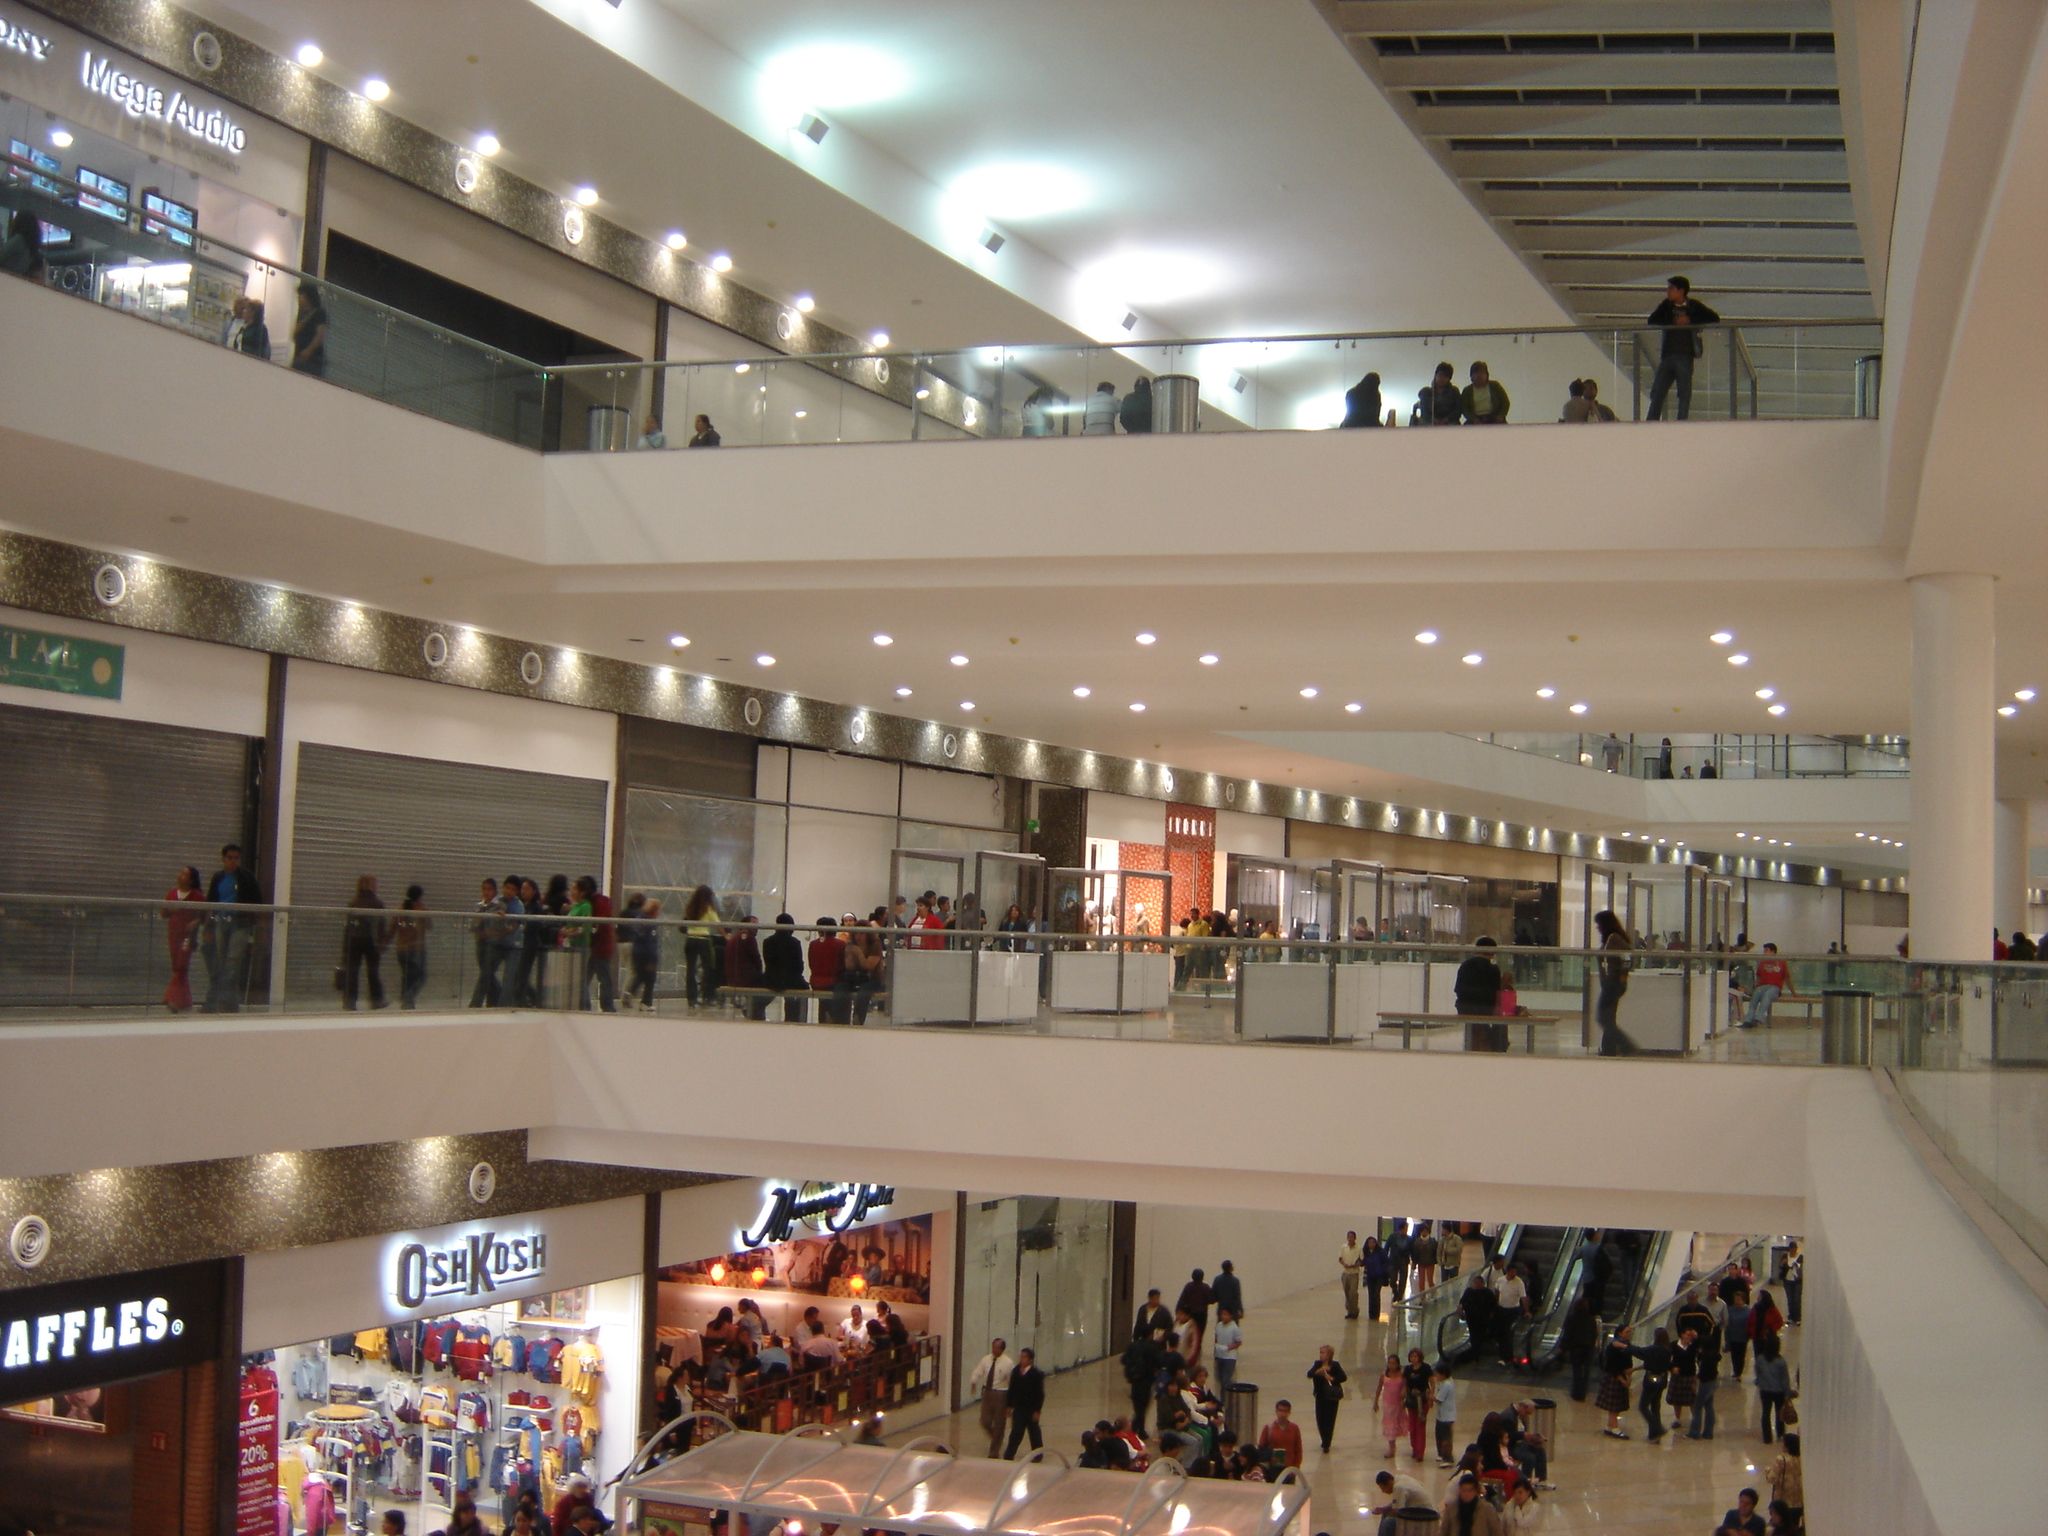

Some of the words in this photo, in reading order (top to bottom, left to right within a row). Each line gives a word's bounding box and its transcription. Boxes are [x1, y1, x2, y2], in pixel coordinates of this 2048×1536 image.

[82, 50, 164, 118] Mega
[165, 91, 248, 153] Audio
[0, 1297, 169, 1368] AFFLES
[248, 1399, 260, 1417] 6
[240, 1444, 269, 1465] 20%
